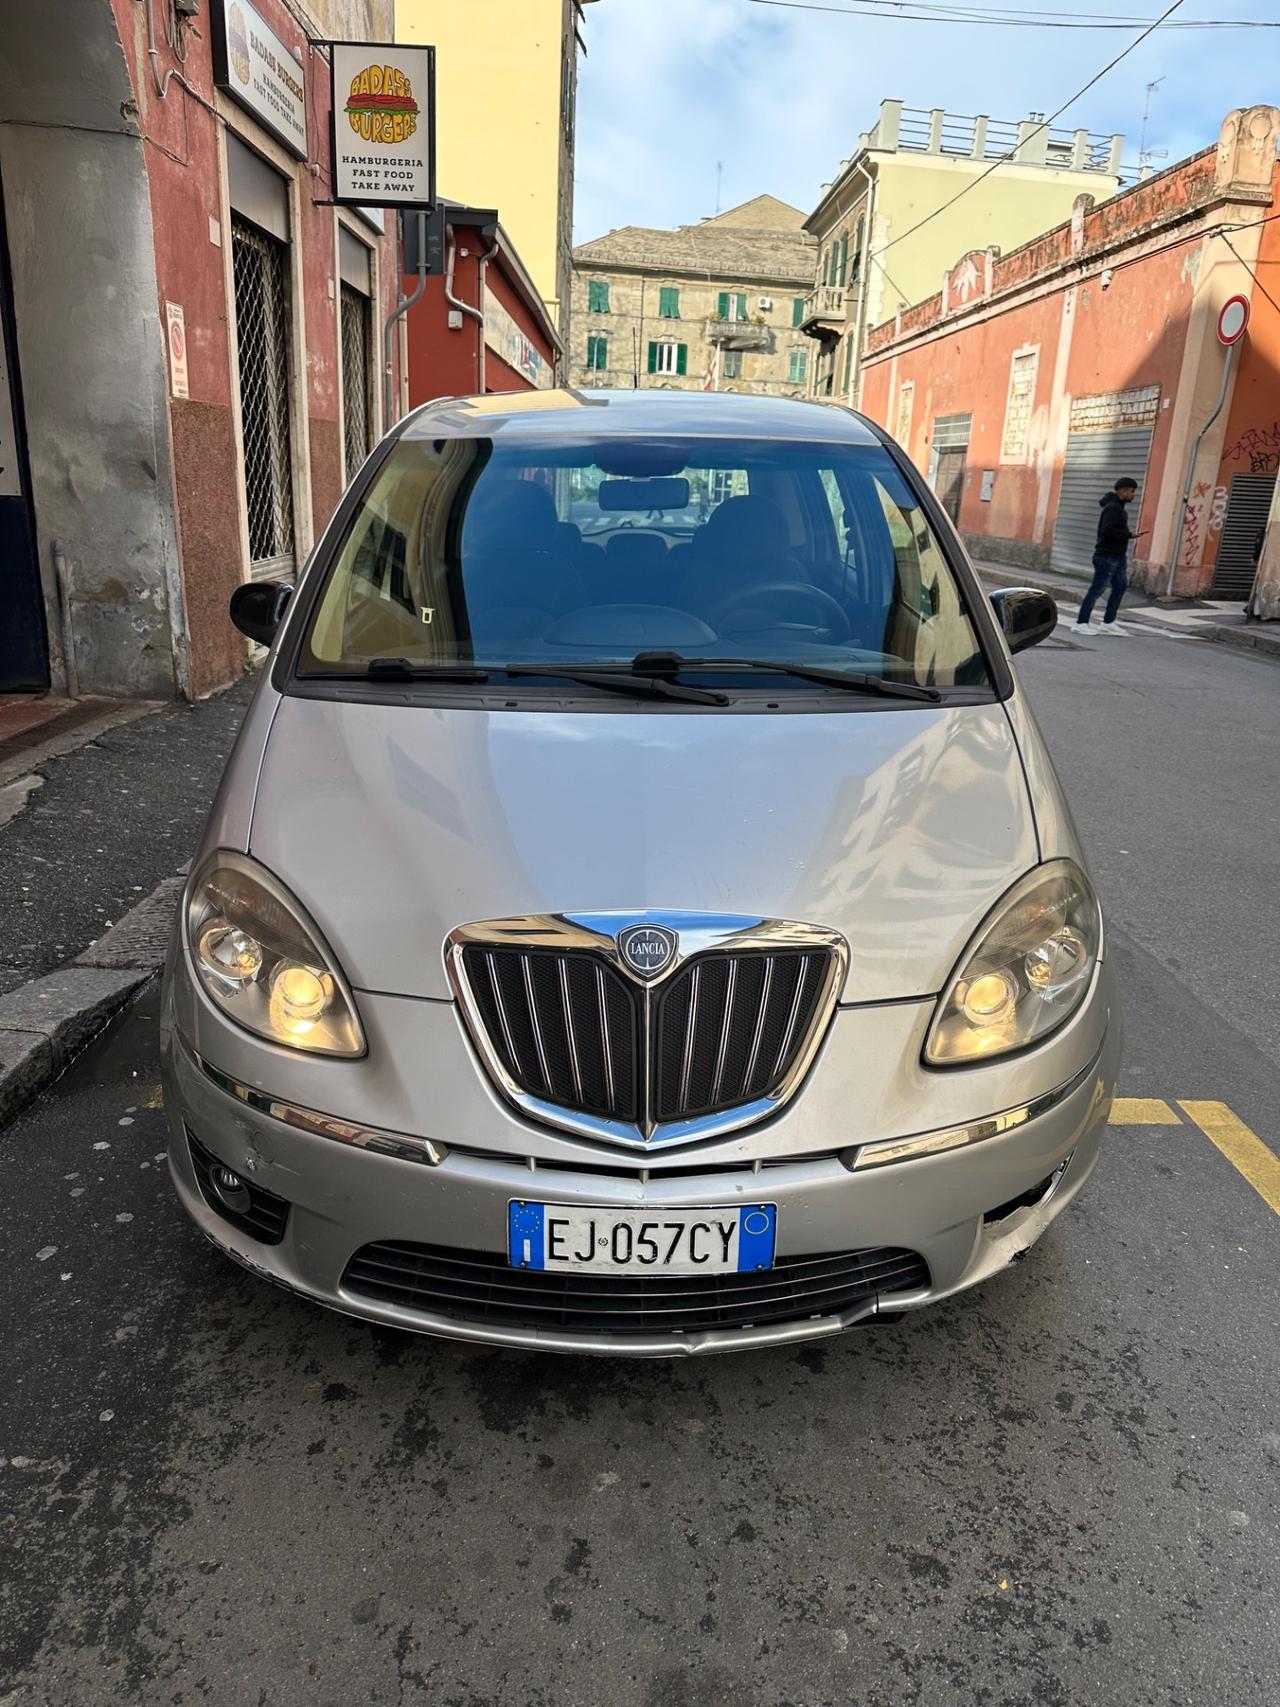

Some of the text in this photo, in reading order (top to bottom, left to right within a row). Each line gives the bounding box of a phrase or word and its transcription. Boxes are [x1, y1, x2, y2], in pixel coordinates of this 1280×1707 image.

[351, 65, 412, 97] BADASS
[349, 112, 417, 144] BURGERS
[342, 155, 423, 167] HAMBURGERIA
[353, 169, 413, 179] FAST FOOD
[351, 182, 415, 192] TAKE AWAY
[631, 942, 665, 955] LANCIA
